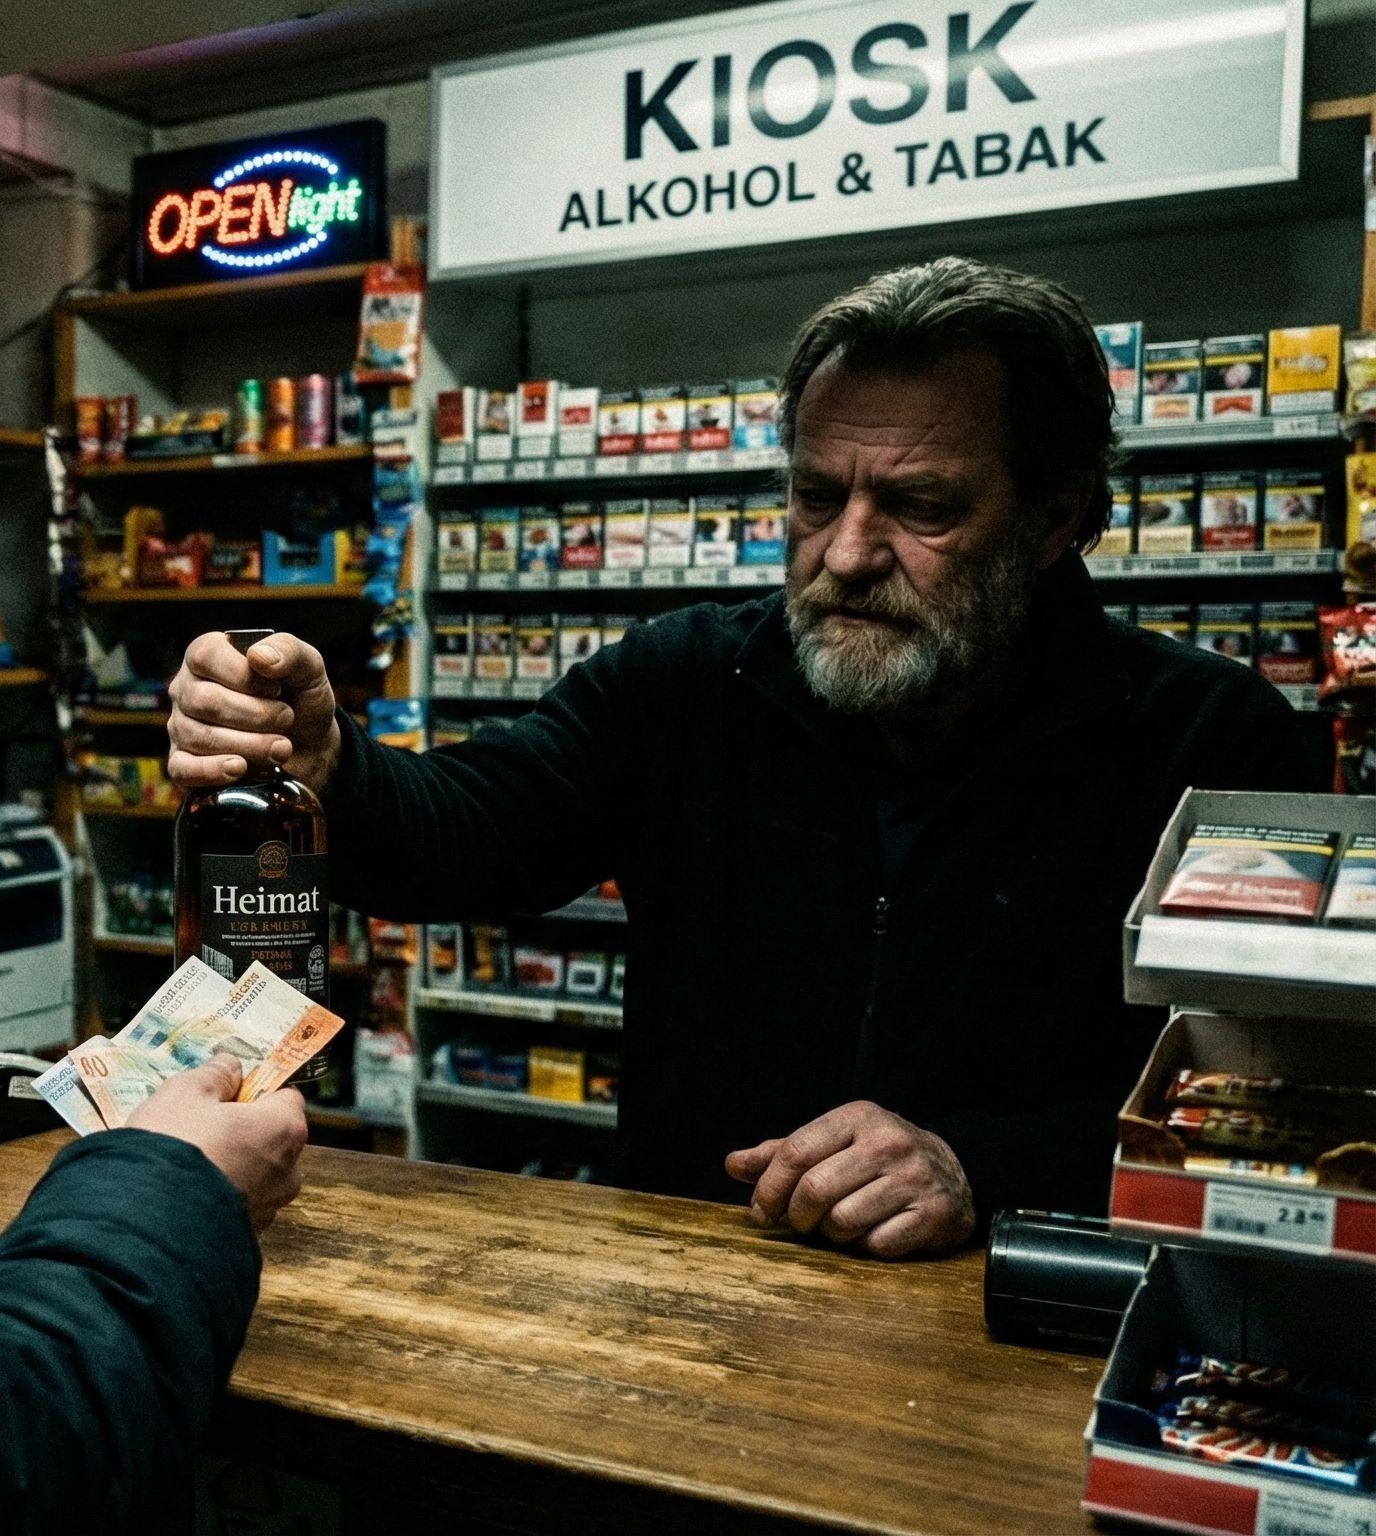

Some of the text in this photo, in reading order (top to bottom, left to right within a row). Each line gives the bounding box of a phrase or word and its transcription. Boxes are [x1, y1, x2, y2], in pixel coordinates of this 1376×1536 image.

[625, 1, 1038, 160] KIOSK
[149, 178, 294, 254] OPEN
[559, 116, 1107, 232] ALKOHOL & TABAK
[212, 885, 320, 915] Heimat
